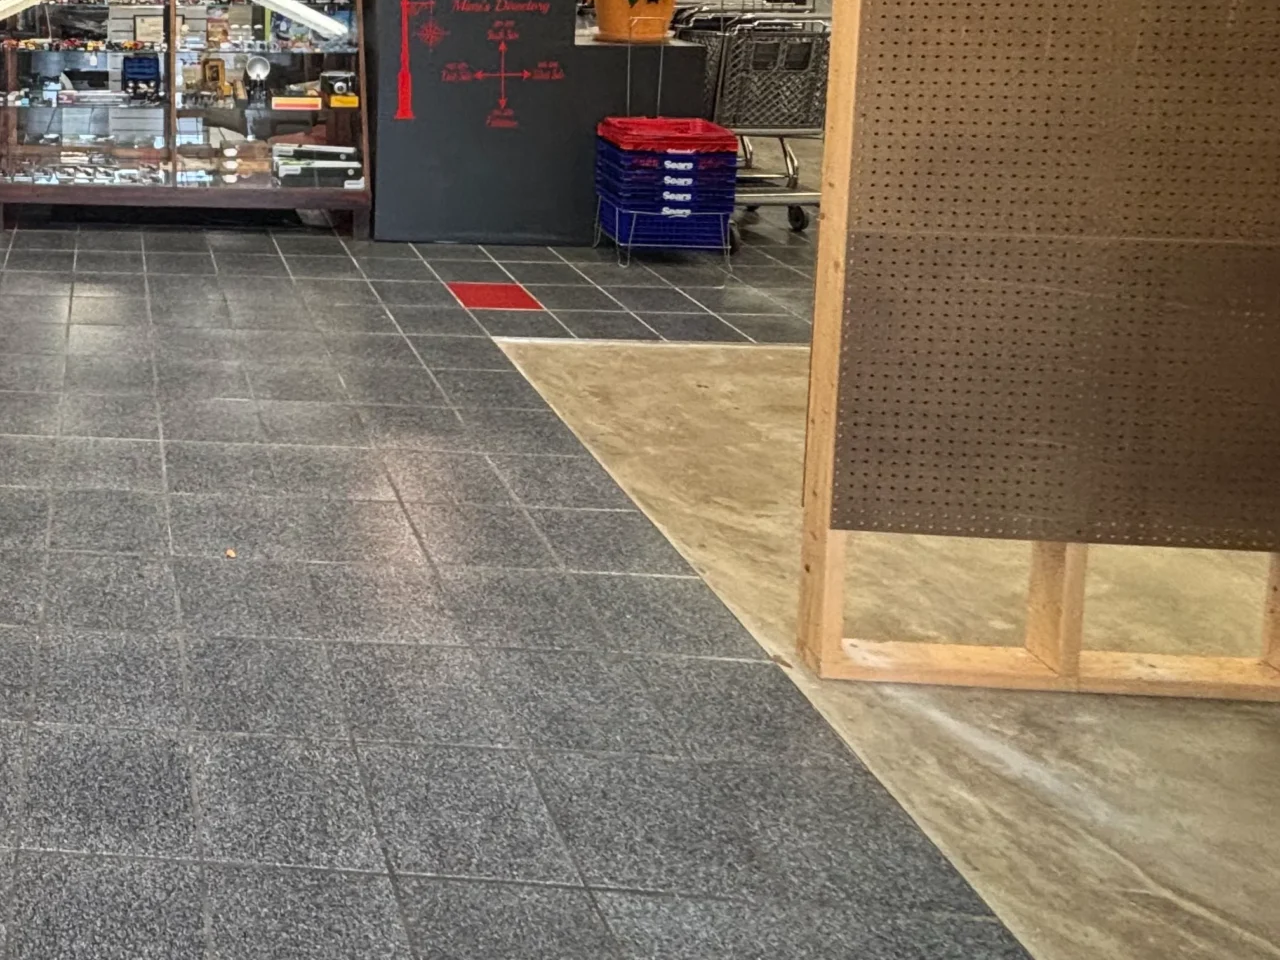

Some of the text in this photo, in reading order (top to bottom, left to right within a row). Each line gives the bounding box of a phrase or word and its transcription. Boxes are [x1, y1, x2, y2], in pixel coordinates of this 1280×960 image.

[664, 160, 693, 171] Sears
[663, 175, 693, 186] Sears
[662, 191, 692, 202] Sears
